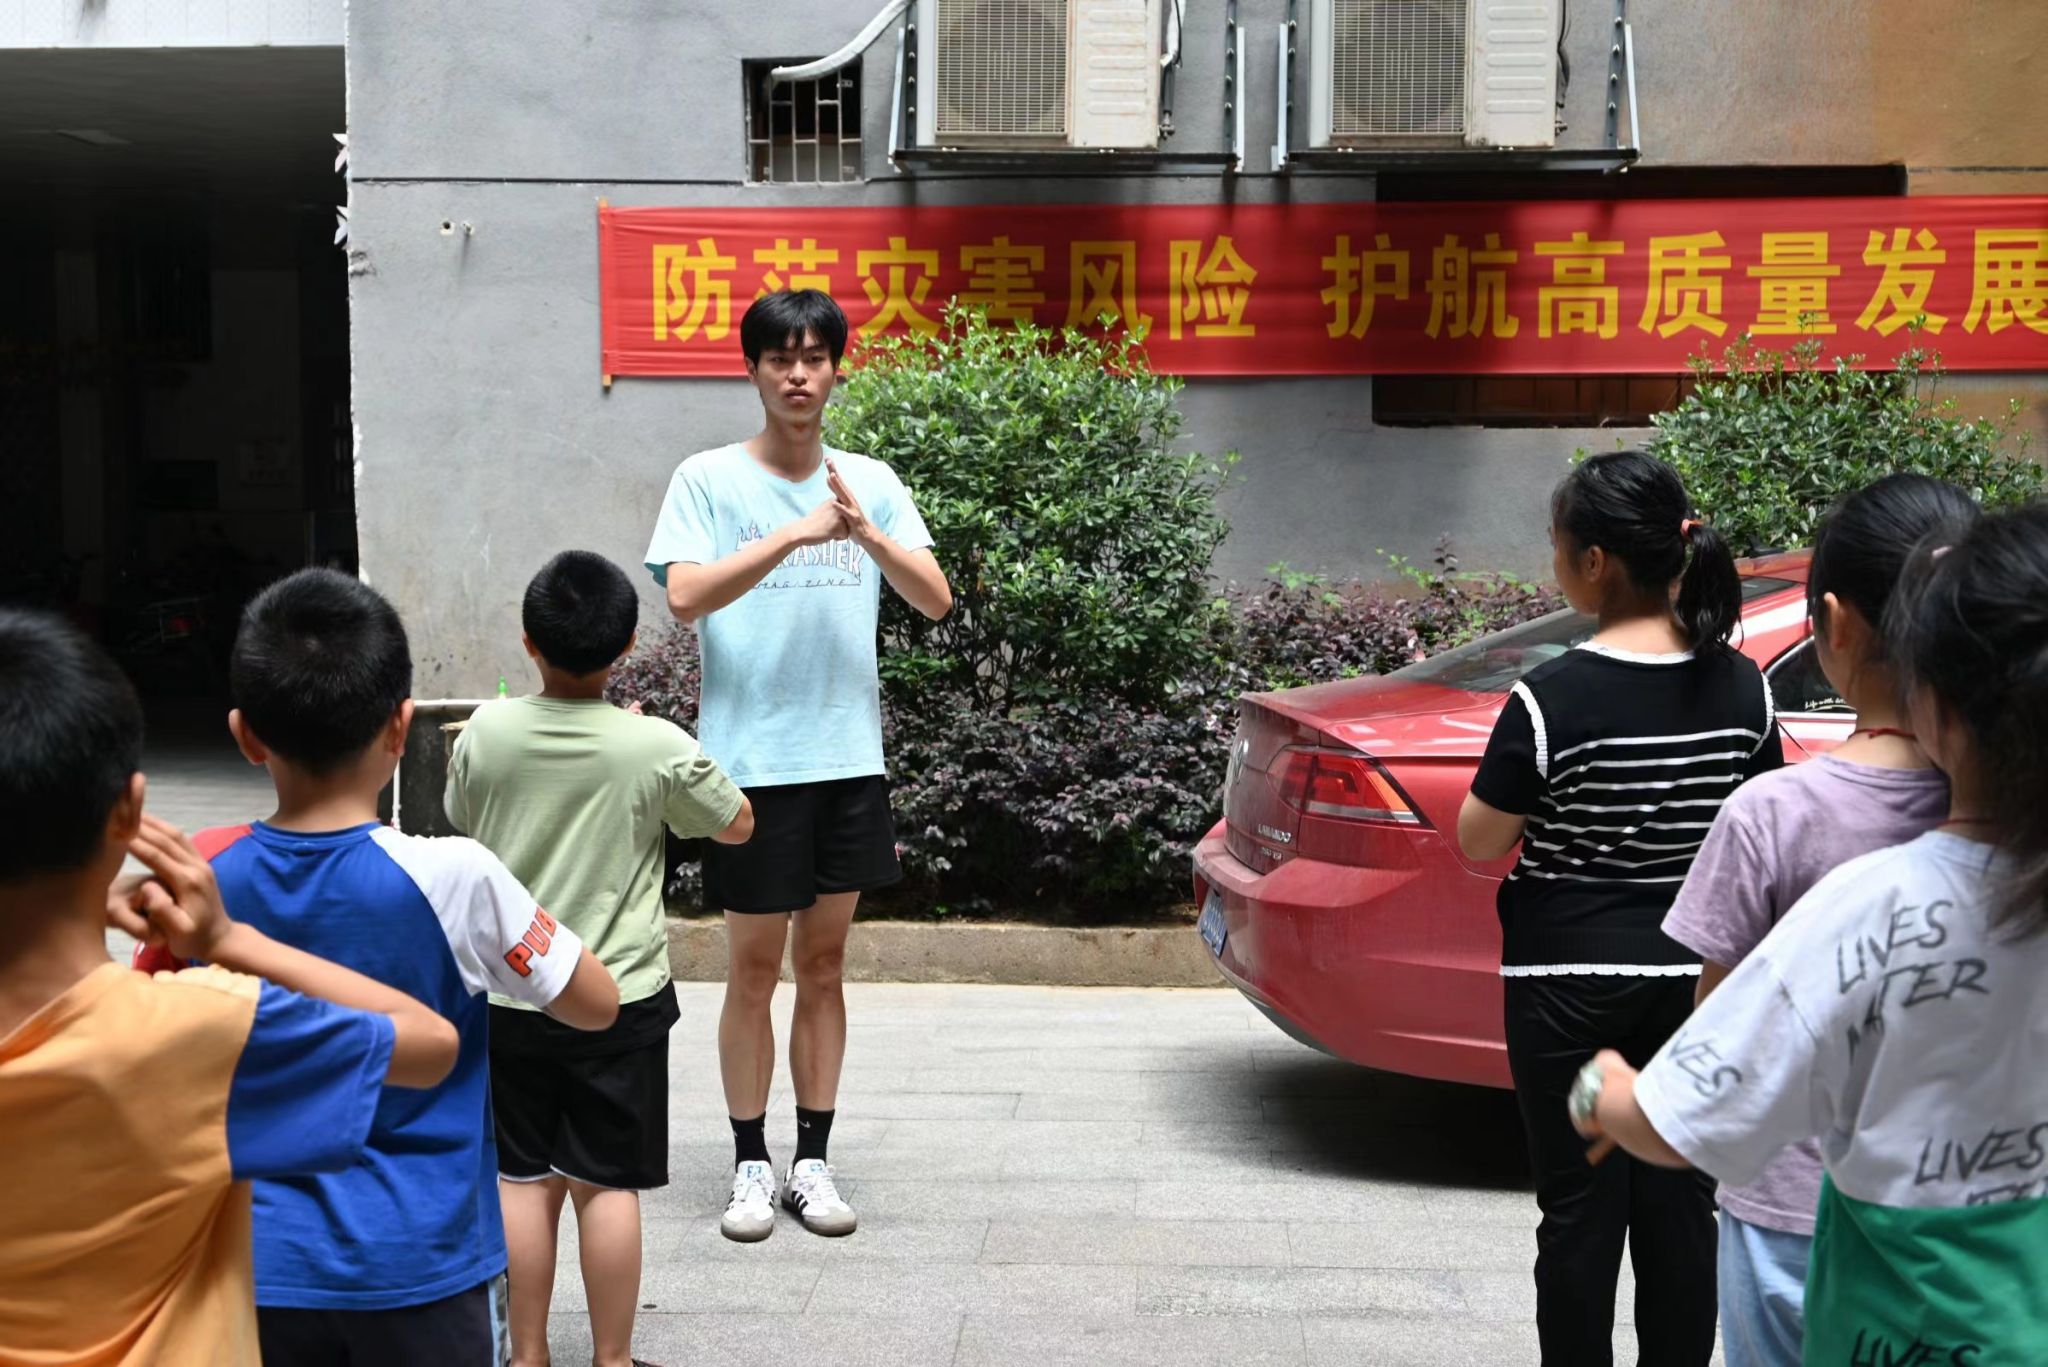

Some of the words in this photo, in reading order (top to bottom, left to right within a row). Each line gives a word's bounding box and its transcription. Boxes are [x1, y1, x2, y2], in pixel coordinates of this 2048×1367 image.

[1320, 228, 2048, 340] 护航高质量发展
[1837, 900, 1953, 994] LIVES
[1913, 1121, 2048, 1187] LIVES
